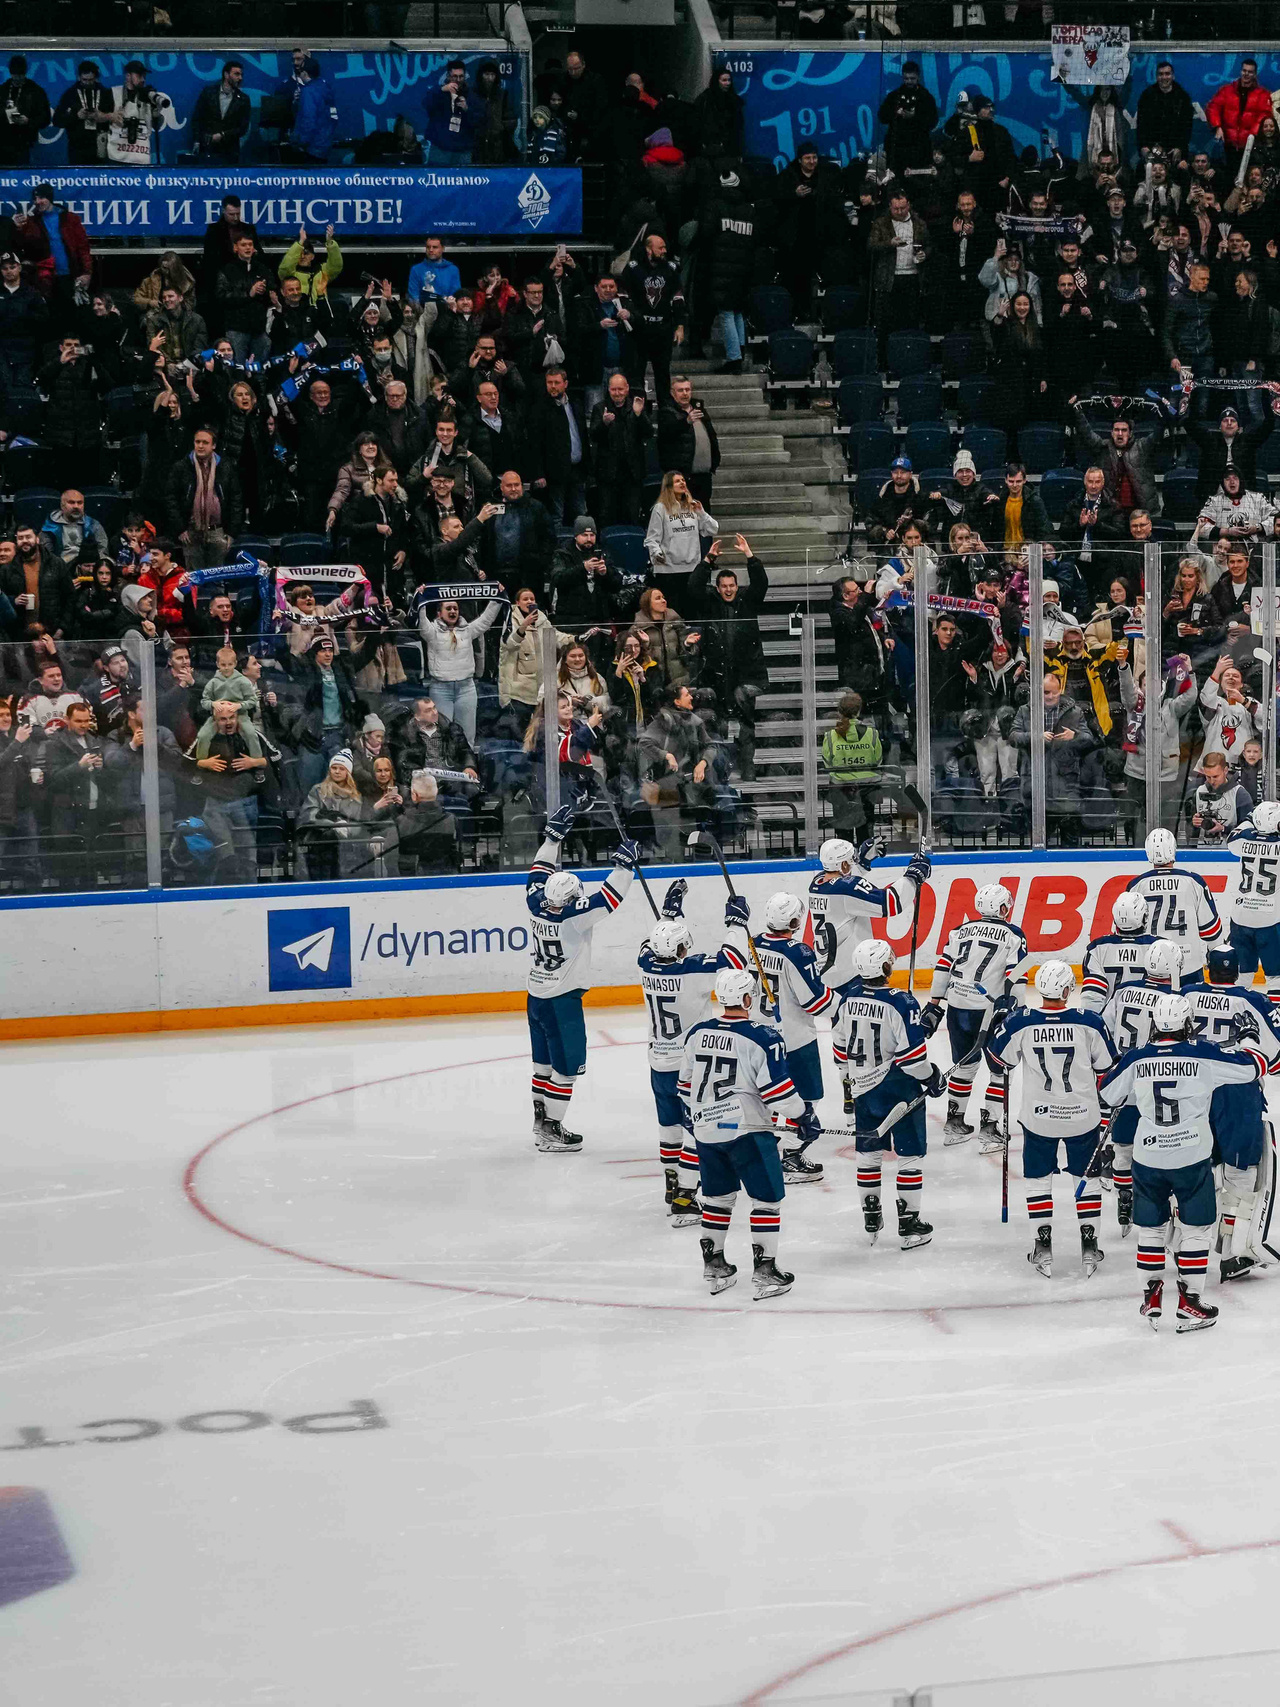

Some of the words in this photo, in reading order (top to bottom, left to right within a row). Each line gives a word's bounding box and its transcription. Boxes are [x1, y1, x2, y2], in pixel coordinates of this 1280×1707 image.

[500, 62, 512, 74] 03
[725, 61, 753, 73] A103
[149, 173, 341, 190] физкультурно-спортивное
[348, 174, 413, 188] общество
[417, 173, 490, 188] «Динамо»
[166, 199, 194, 225] И
[204, 199, 403, 225] ЕИНСТВЕ!
[721, 217, 753, 236] PUMA
[289, 566, 356, 579] торпедо
[437, 585, 499, 599] торпедо
[836, 742, 870, 752] STEWARD
[842, 756, 866, 766] 1545
[1241, 844, 1273, 857] FEDOTOV
[1149, 878, 1180, 892] ORLOV
[1239, 857, 1279, 896] 65
[1143, 894, 1187, 937] 74
[957, 925, 1008, 943] GONCHARUK
[950, 939, 1001, 982] 27
[1118, 949, 1138, 963] YAN
[1120, 988, 1160, 1008] KOVALEN
[1197, 996, 1230, 1012] HUSKA
[645, 993, 683, 1041] 16
[701, 1034, 734, 1052] BOKUN
[846, 1019, 883, 1068] 41
[1033, 1027, 1074, 1043] DARYIN
[695, 1053, 738, 1103] 72
[1033, 1046, 1075, 1093] 17
[1136, 1061, 1200, 1079] KONYUSHKOV
[1152, 1080, 1181, 1127] 6
[1182, 1305, 1207, 1319] CCM
